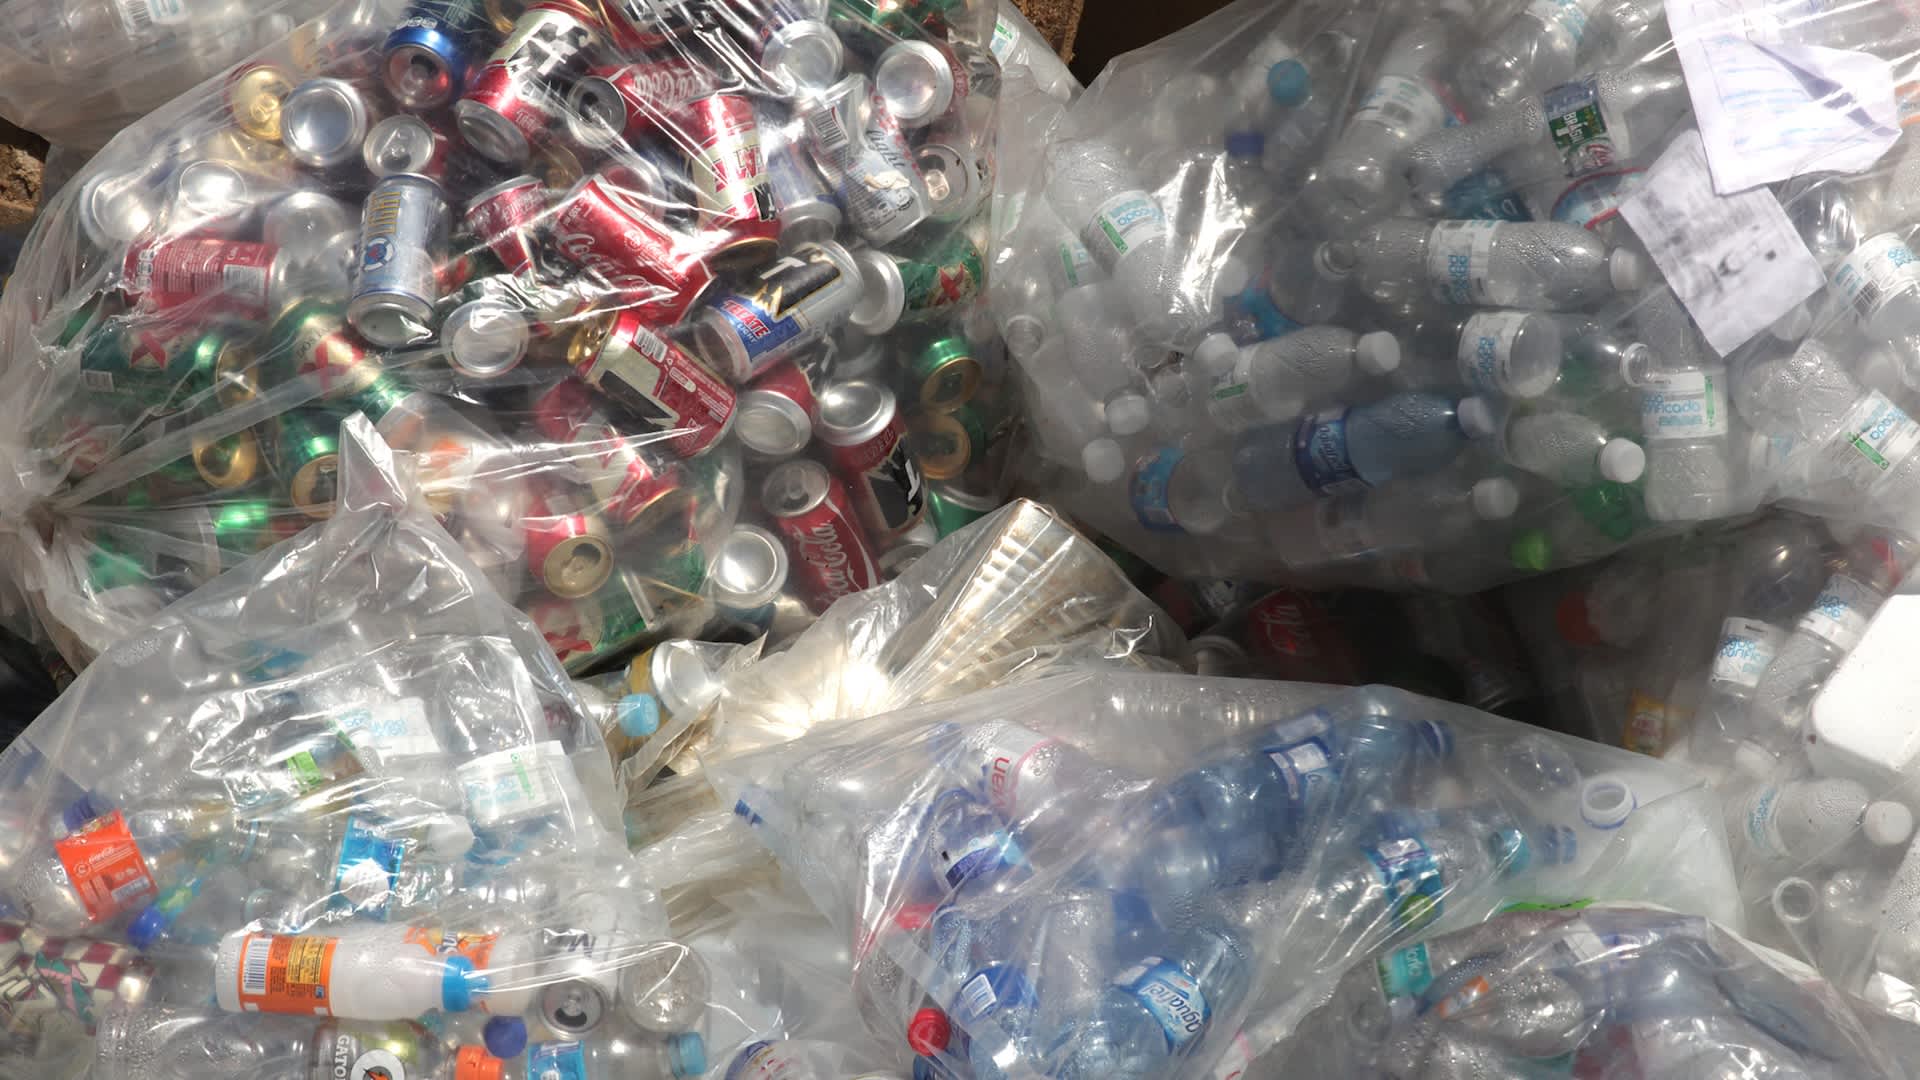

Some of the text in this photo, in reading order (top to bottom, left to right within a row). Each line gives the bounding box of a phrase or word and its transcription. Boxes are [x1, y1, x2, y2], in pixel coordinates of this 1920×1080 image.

[722, 299, 771, 341] TECATE
[736, 321, 758, 345] LIGHT
[991, 756, 1011, 809] vian
[1138, 982, 1202, 1034] aguafiel
[334, 1033, 351, 1080] GATO
